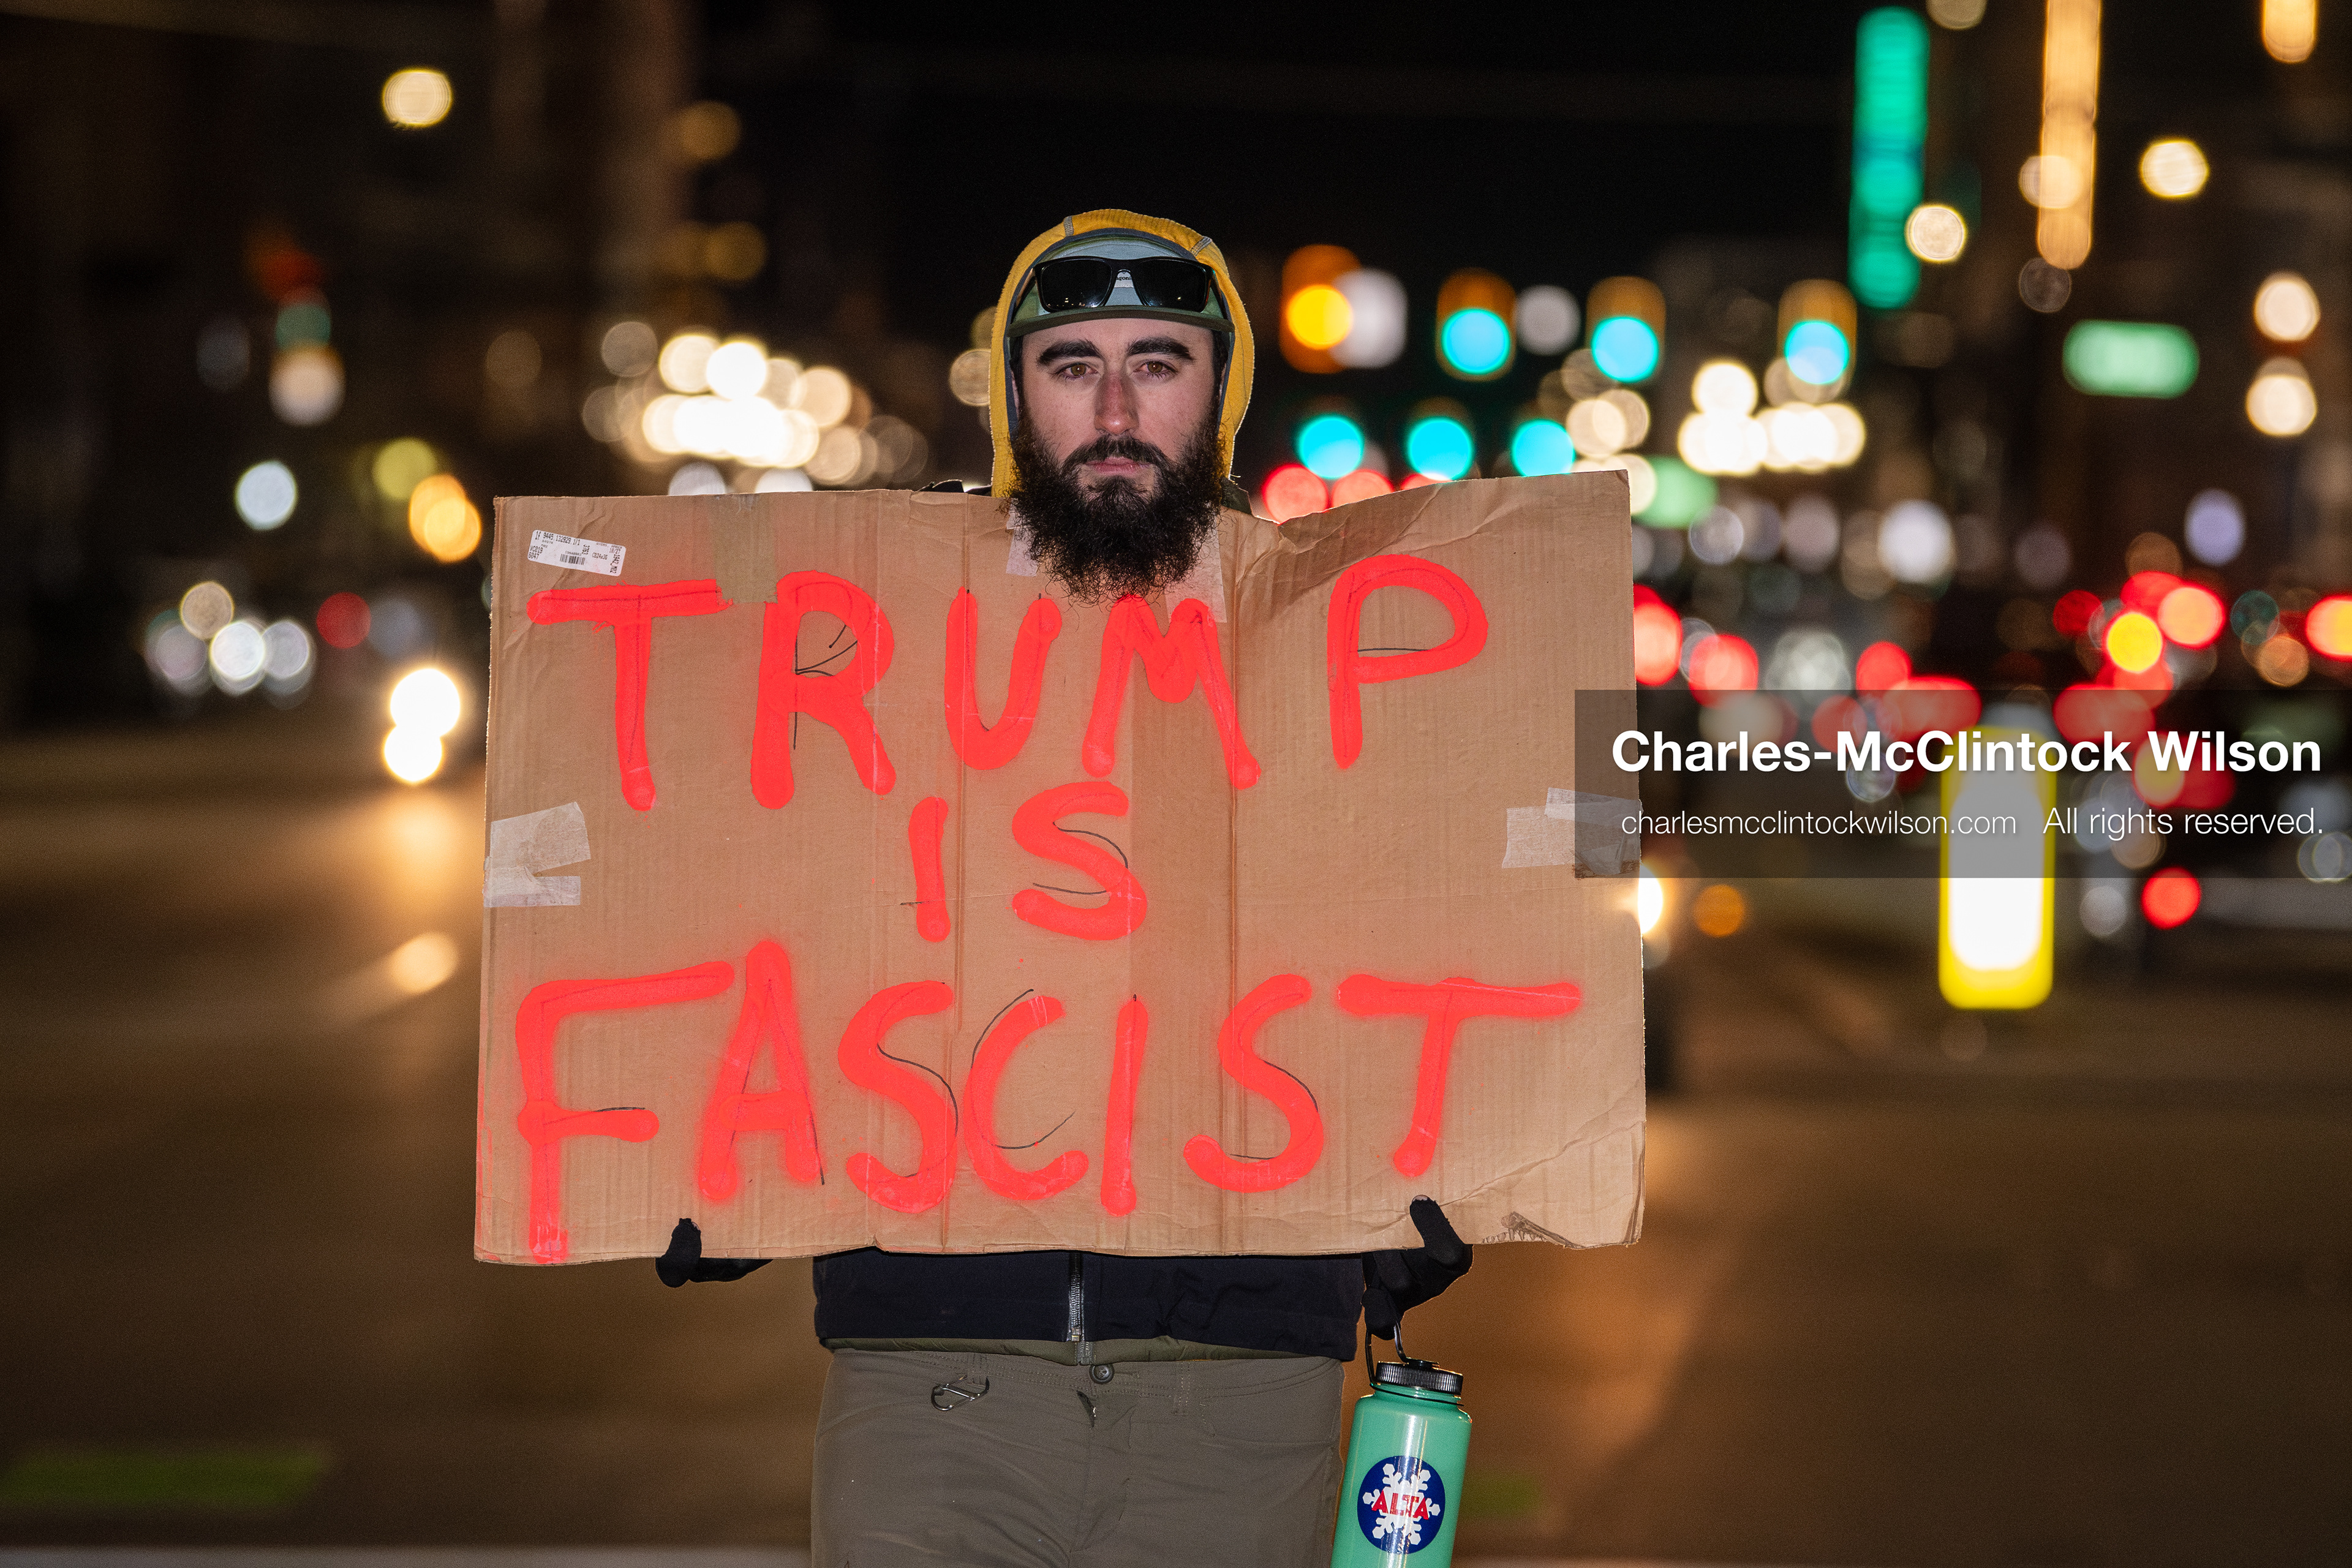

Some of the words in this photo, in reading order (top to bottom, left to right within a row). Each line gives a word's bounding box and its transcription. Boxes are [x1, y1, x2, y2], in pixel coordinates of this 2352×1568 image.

[527, 554, 1488, 812] TRUMP
[908, 781, 1147, 942] IS
[516, 940, 1581, 1264] FASCIST
[1371, 1489, 1430, 1520] ALTA
